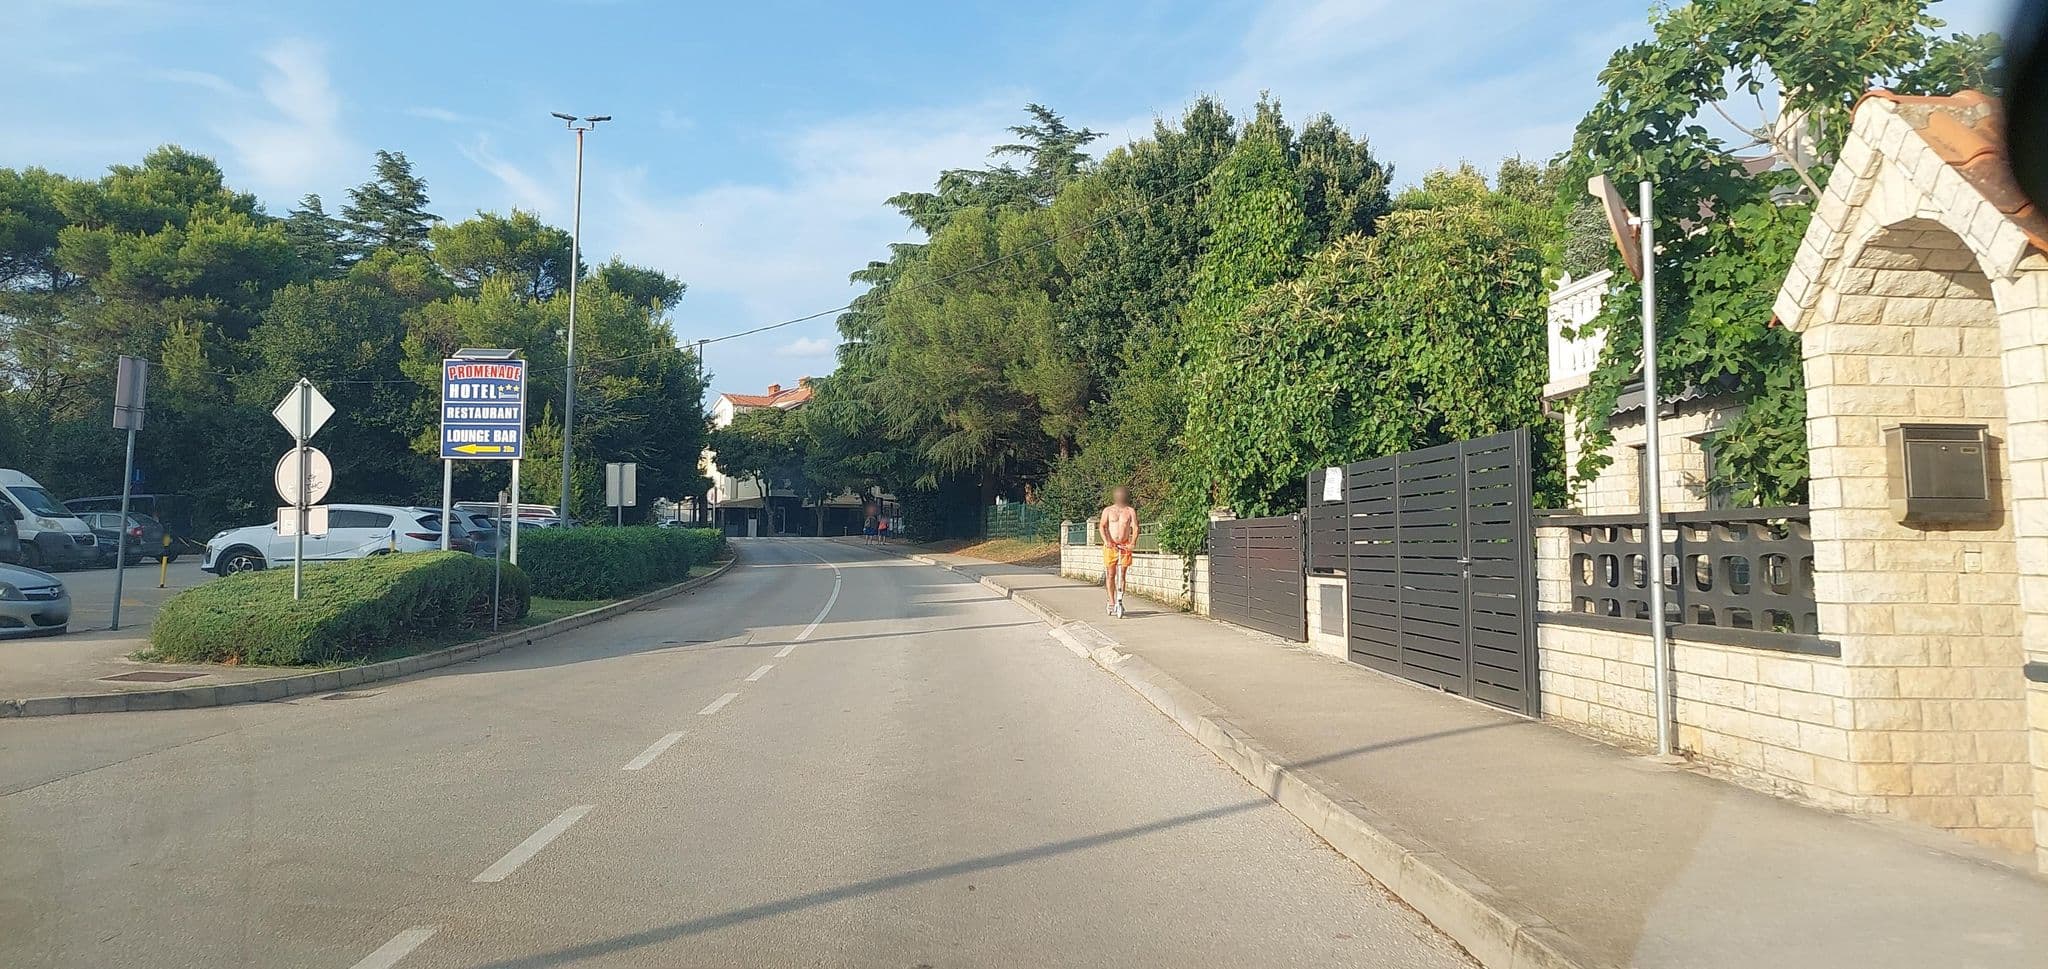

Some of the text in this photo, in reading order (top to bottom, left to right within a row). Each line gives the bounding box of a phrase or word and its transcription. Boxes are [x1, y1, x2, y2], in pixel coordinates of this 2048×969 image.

[448, 365, 521, 381] PROMENADE
[449, 384, 496, 399] HOTEL
[447, 407, 519, 419] RESTAURANT
[447, 430, 517, 442] LOUNGE BAR
